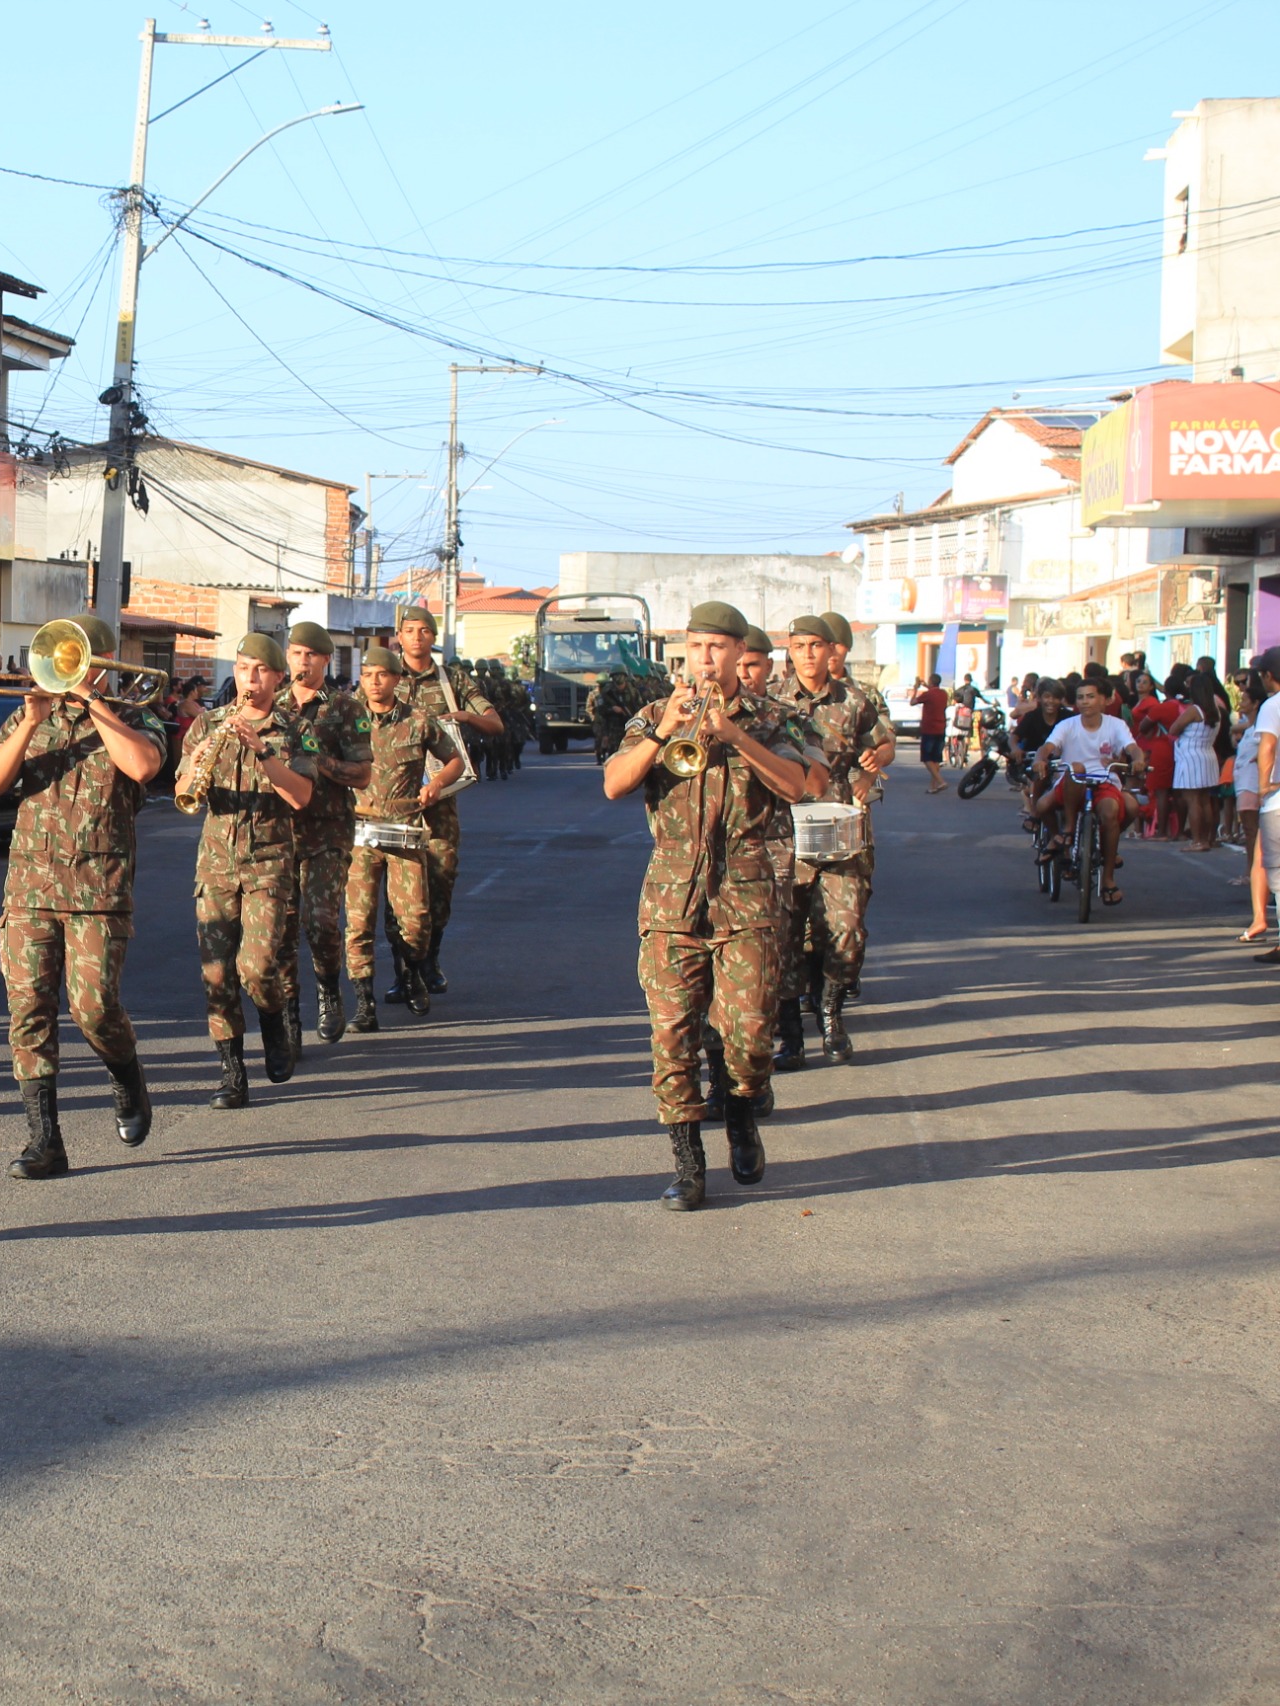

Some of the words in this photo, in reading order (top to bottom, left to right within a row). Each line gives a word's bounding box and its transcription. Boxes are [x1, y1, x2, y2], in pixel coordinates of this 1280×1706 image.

[1169, 417, 1260, 430] FARMÁCIA
[1169, 429, 1271, 454] NOVA
[1169, 453, 1280, 475] FARMA
